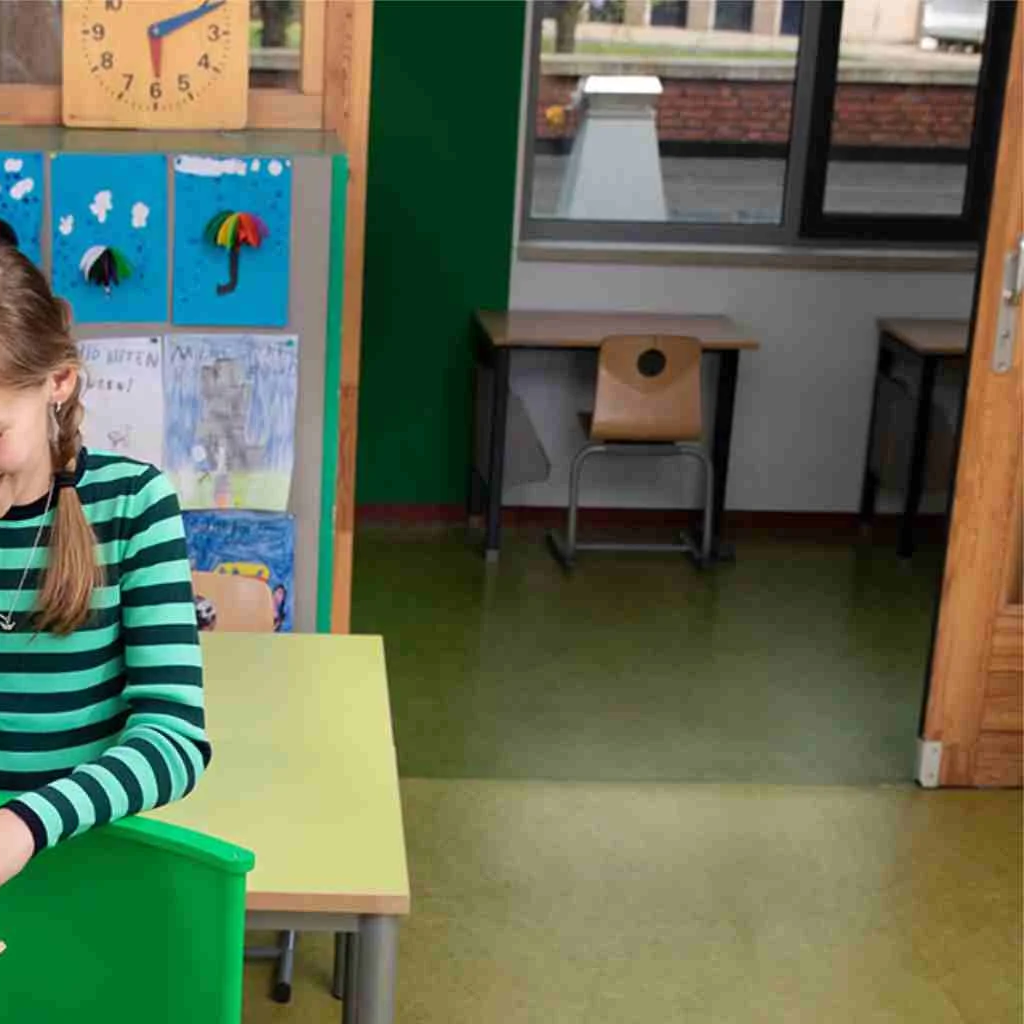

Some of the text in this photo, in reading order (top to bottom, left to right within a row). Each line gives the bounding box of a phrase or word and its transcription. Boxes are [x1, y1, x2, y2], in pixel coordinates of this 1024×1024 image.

[91, 24, 105, 41] 9
[208, 24, 221, 42] 3
[101, 52, 114, 70] 8
[197, 53, 211, 70] 4
[122, 73, 134, 92] 7
[150, 82, 162, 99] 6
[178, 74, 190, 92] 5
